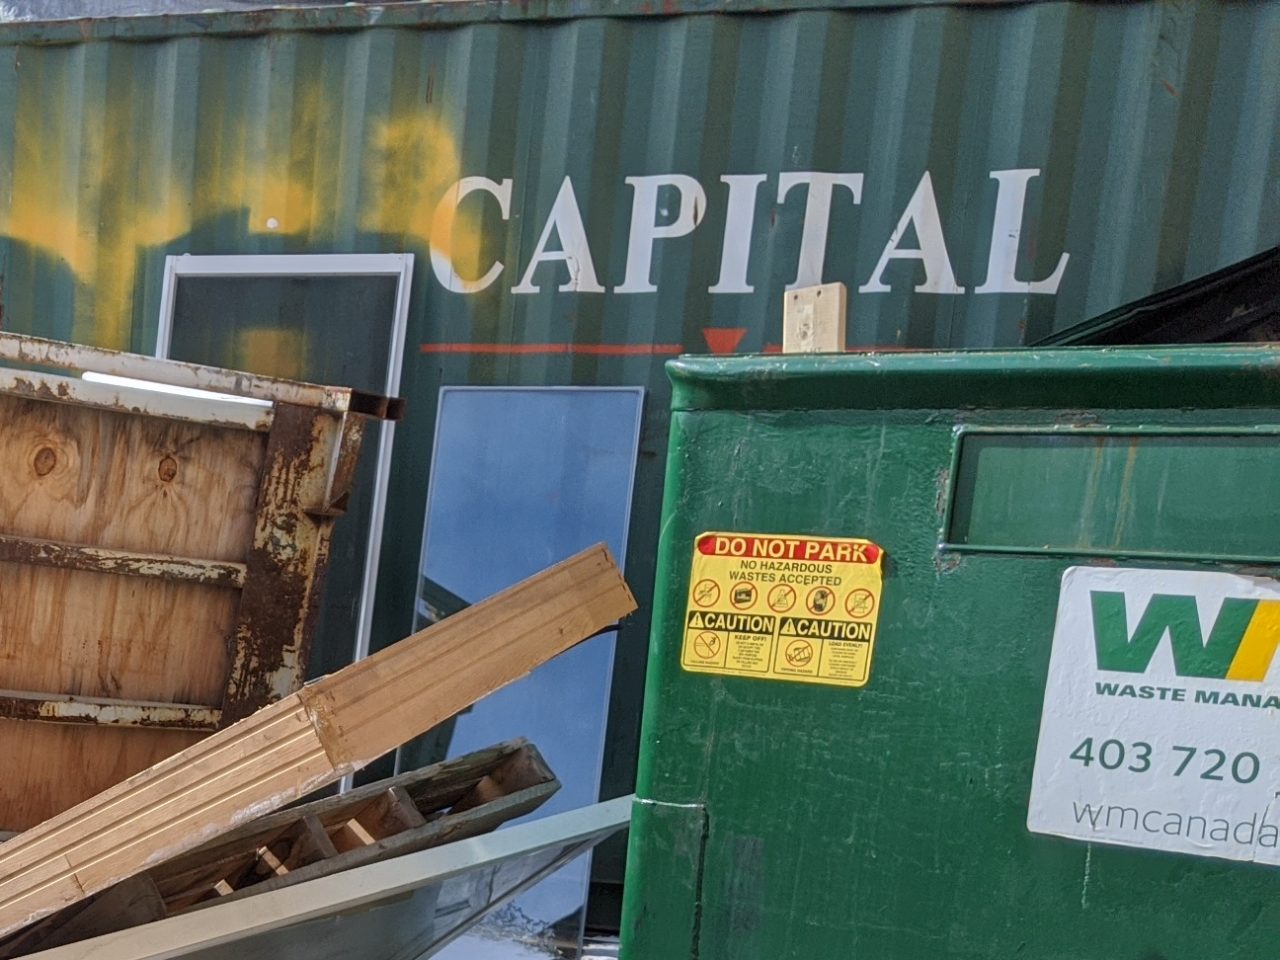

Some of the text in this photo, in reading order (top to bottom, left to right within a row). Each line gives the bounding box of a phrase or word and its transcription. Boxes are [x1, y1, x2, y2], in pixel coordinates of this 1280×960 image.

[428, 168, 1070, 295] CAPITAL
[715, 537, 868, 562] DO NOT PARK
[740, 560, 833, 574] NO HAZARDOUS
[729, 571, 842, 587] WASTES ACCEPTED
[704, 613, 774, 632] CAUTION
[796, 620, 870, 640] CAUTION
[1095, 682, 1186, 702] WASTE
[1069, 737, 1260, 784] 403 720
[1073, 801, 1279, 848] wmcanada
